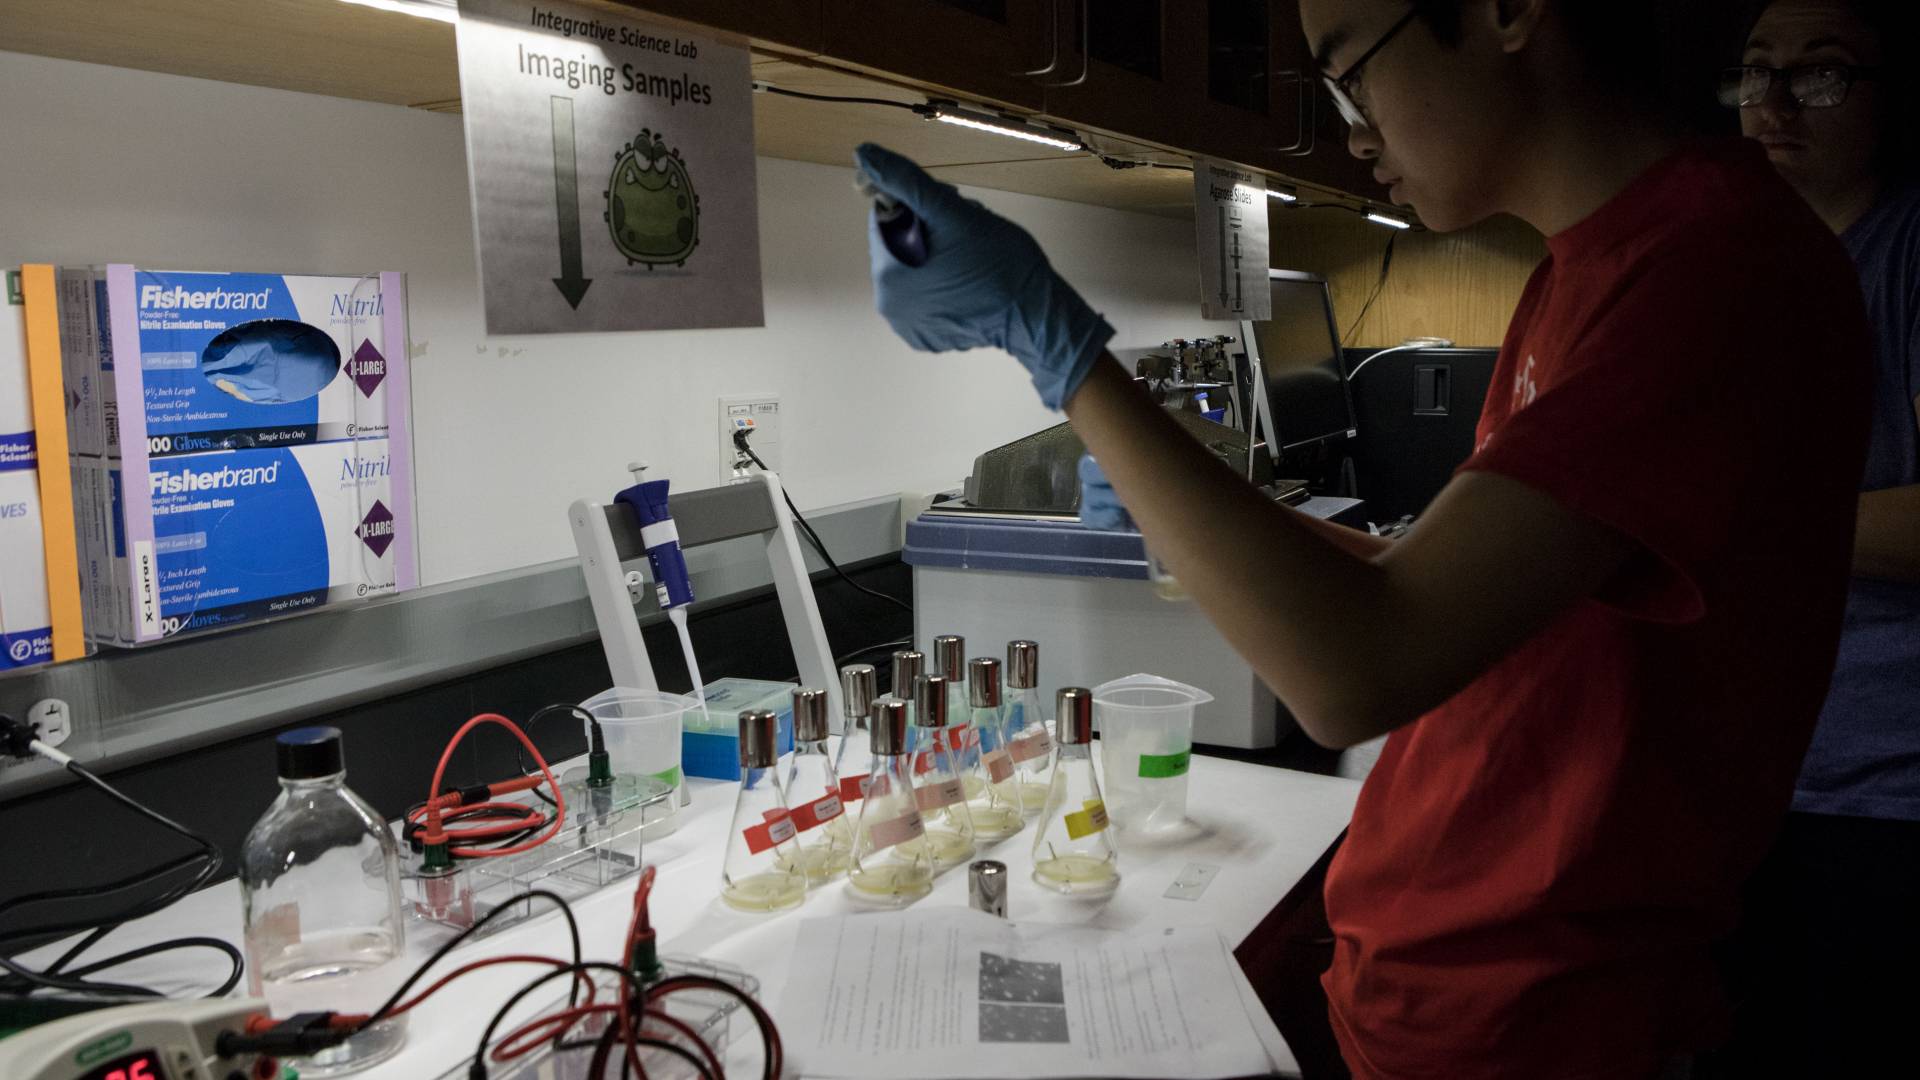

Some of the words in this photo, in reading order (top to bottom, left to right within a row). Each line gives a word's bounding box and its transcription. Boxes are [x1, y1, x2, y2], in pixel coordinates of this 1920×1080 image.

[531, 6, 616, 43] Integrative
[619, 26, 671, 54] Science
[674, 38, 698, 59] Lab
[518, 43, 617, 95] Imaging
[622, 63, 712, 105] Samples
[1234, 187, 1252, 205] Slides
[140, 285, 271, 310] Fisherbrand
[330, 293, 385, 316] Nitril
[140, 311, 179, 319] Powder-Free
[140, 321, 161, 329] Nitrile
[163, 321, 202, 329] Examination
[204, 320, 226, 329] Gloves
[350, 360, 385, 376] X-LARGE
[159, 387, 173, 396] Inch
[174, 386, 196, 396] Length
[146, 401, 174, 410] Textured
[146, 413, 183, 423] Non-Sterile
[184, 411, 228, 421] Ambidextrous
[259, 431, 278, 441] Single
[279, 431, 291, 440] Use
[292, 430, 306, 439] Only
[0, 444, 31, 453] Fisher
[147, 436, 171, 454] 100
[174, 435, 211, 452] Gloves
[341, 454, 391, 481] Nitril
[149, 461, 278, 495] Fisherbrand
[152, 495, 187, 504] owder-Free
[153, 504, 169, 515] itrile
[171, 500, 212, 513] Examination
[212, 498, 235, 509] Gloves
[0, 502, 27, 519] VES
[168, 569, 183, 579] Inch
[184, 566, 207, 577] Length
[142, 555, 153, 623] X-Large
[160, 582, 185, 592] extured
[185, 580, 201, 590] Grip
[160, 594, 193, 605] on-Sterile
[269, 600, 288, 611] Single
[289, 599, 301, 607] Use
[302, 597, 316, 605] Only
[161, 617, 179, 634] 00
